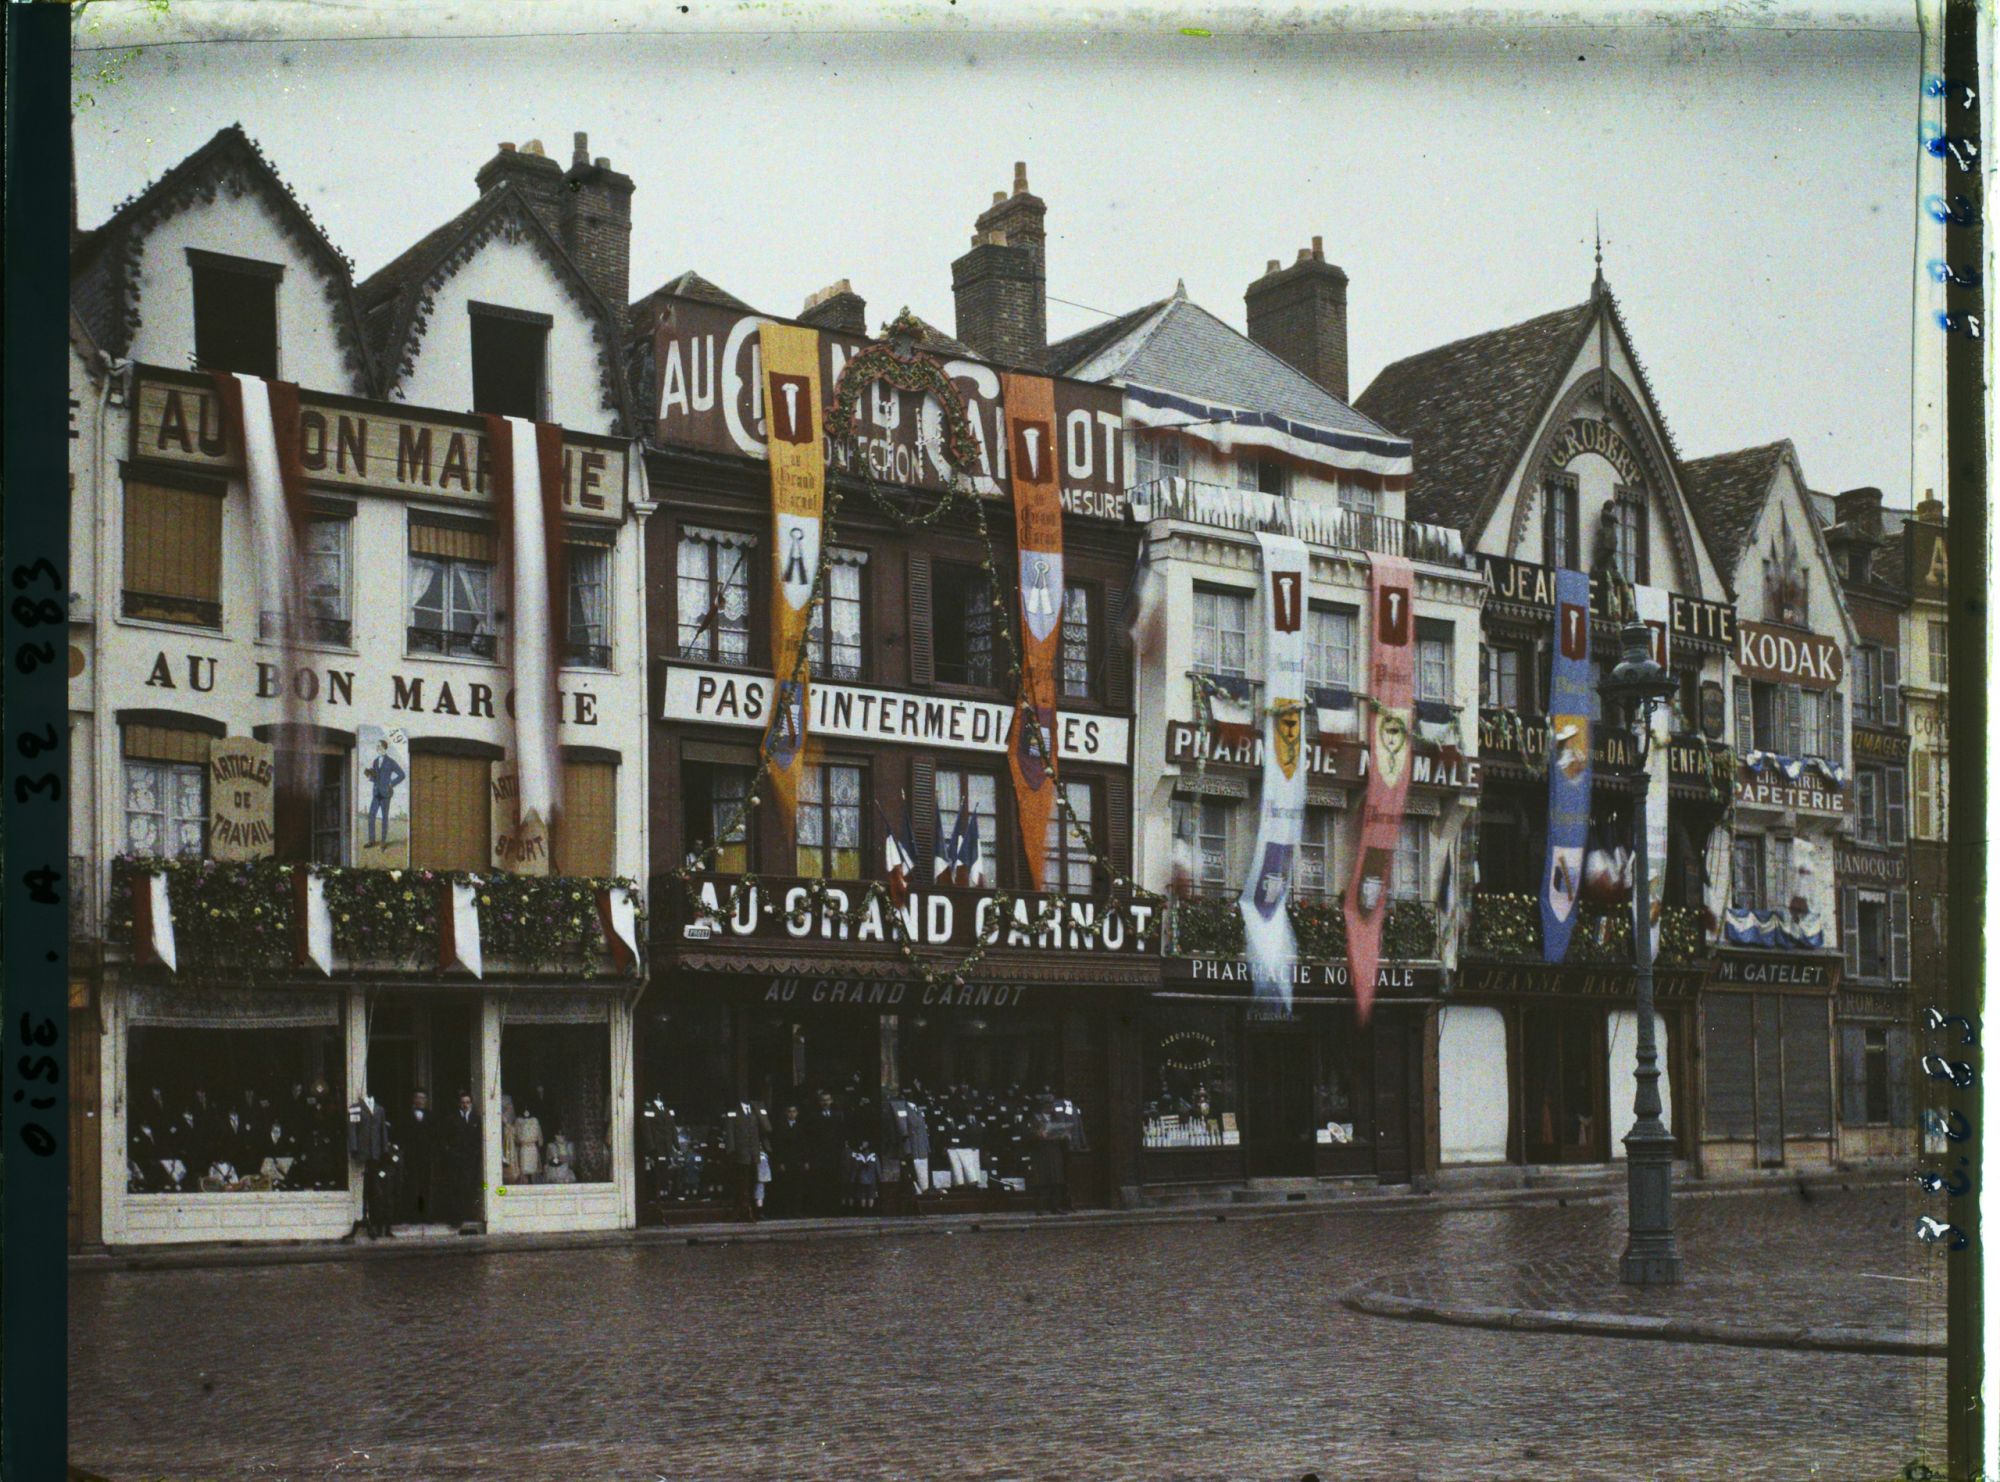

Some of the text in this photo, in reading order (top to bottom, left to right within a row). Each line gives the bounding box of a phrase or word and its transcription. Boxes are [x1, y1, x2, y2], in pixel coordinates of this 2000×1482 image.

[660, 334, 715, 420] AU
[157, 388, 227, 456] AU
[300, 411, 368, 477] ON
[823, 436, 924, 483] ONFECTION
[1502, 563, 1600, 614] JEAE
[146, 651, 217, 692] AU
[1738, 632, 1838, 682] KODAK
[696, 676, 1100, 757] PAS 'INTERMÉDIES
[211, 754, 273, 787] ARTICLES
[1358, 745, 1481, 789] NMALE
[234, 791, 251, 809] DE
[211, 813, 273, 848] TRAVAIL
[697, 880, 1153, 952] AU GRAND CARNOT
[765, 978, 1028, 1007] AU GRAND CARNOT
[1324, 967, 1414, 988] NOALE
[1479, 970, 1564, 993] JEANNE
[1582, 974, 1689, 996] HACHTTE
[1743, 963, 1824, 984] GATELET
